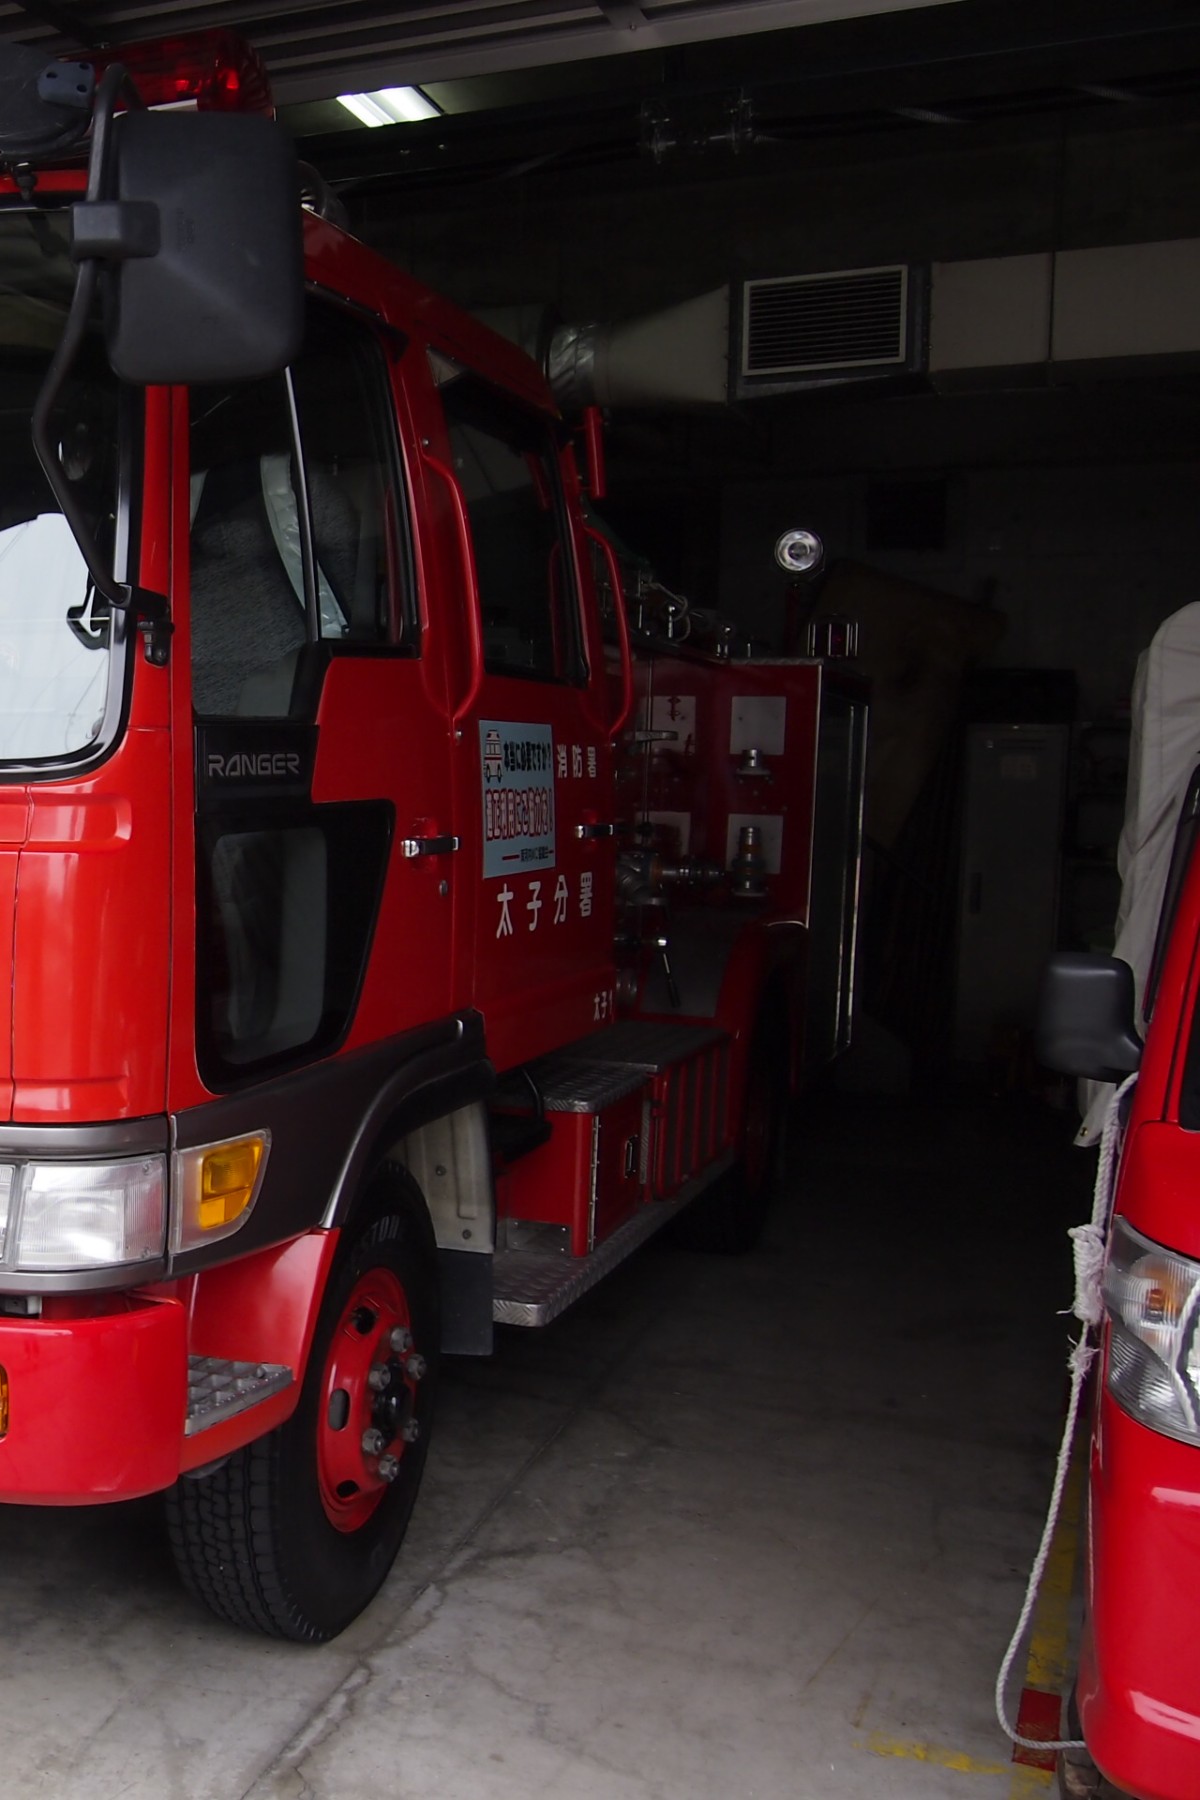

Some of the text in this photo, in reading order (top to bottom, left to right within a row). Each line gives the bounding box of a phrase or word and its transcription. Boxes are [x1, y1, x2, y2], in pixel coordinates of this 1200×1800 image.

[208, 753, 300, 777] RANGER
[557, 744, 597, 779] 消防署
[496, 871, 594, 939] 太子分署
